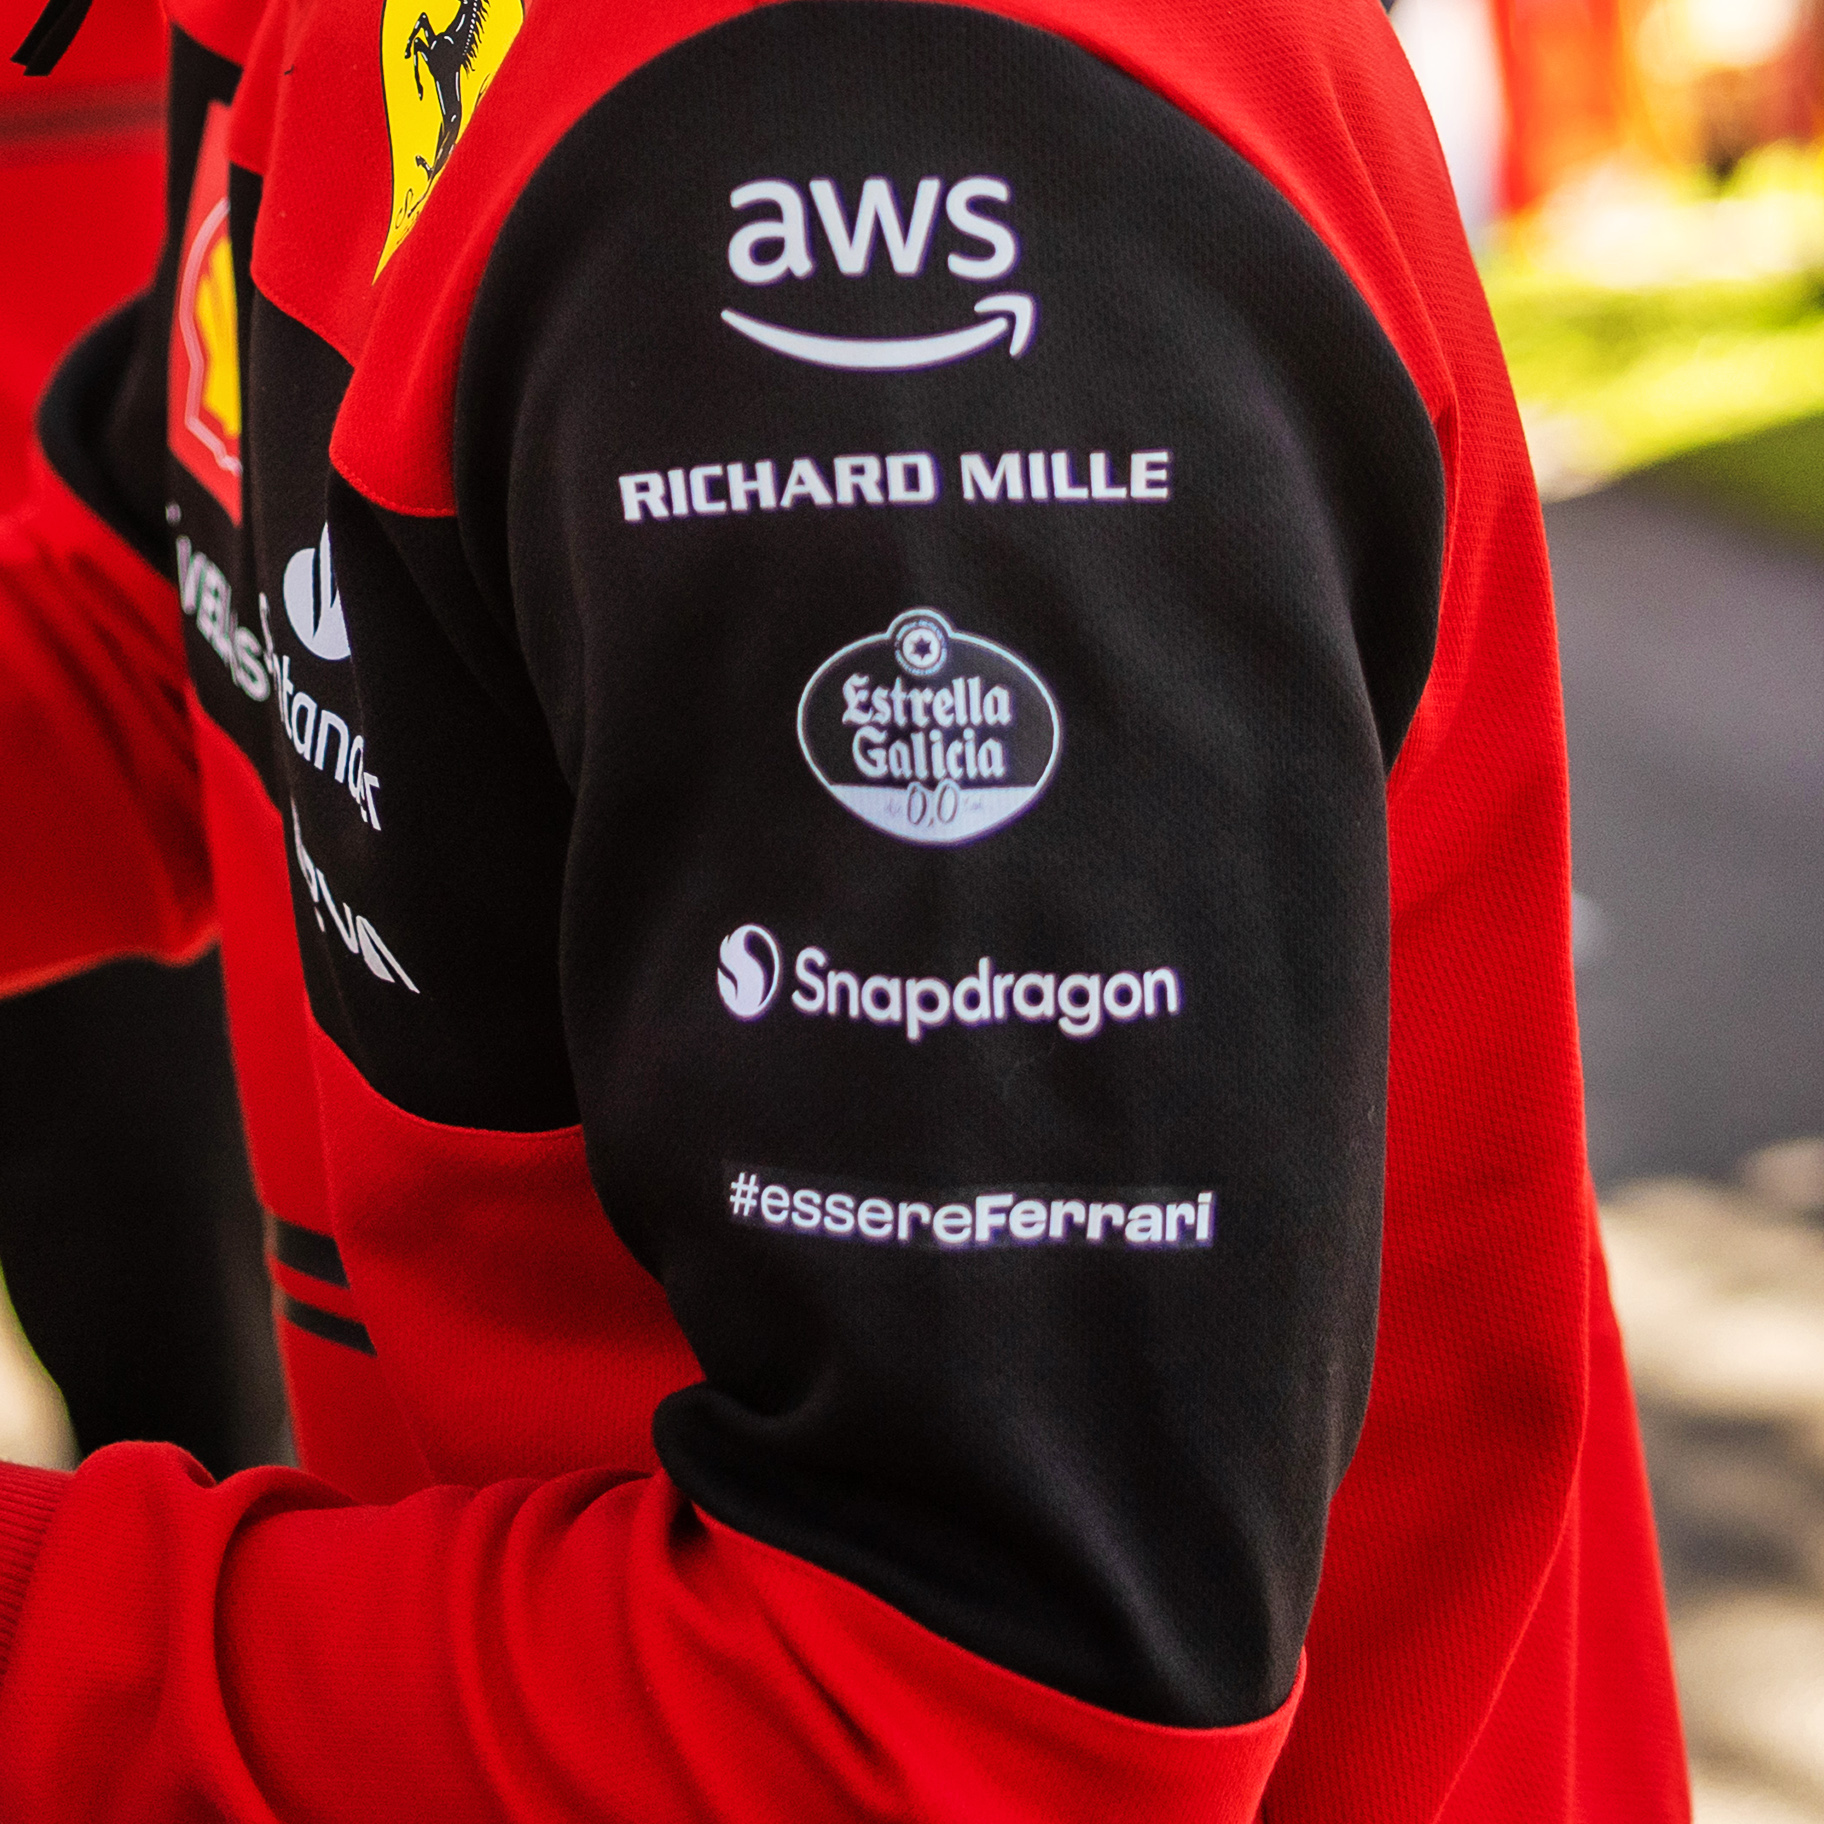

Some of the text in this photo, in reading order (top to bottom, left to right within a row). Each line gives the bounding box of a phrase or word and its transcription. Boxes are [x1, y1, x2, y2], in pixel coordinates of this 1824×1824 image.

[727, 175, 1018, 286] aws
[619, 451, 1169, 520] RICHARD MILLE
[841, 673, 1012, 727] Estrella
[852, 725, 1005, 780] Galicia
[791, 946, 1180, 1042] Snapdragon
[728, 1171, 1216, 1247] #essereFerrari
